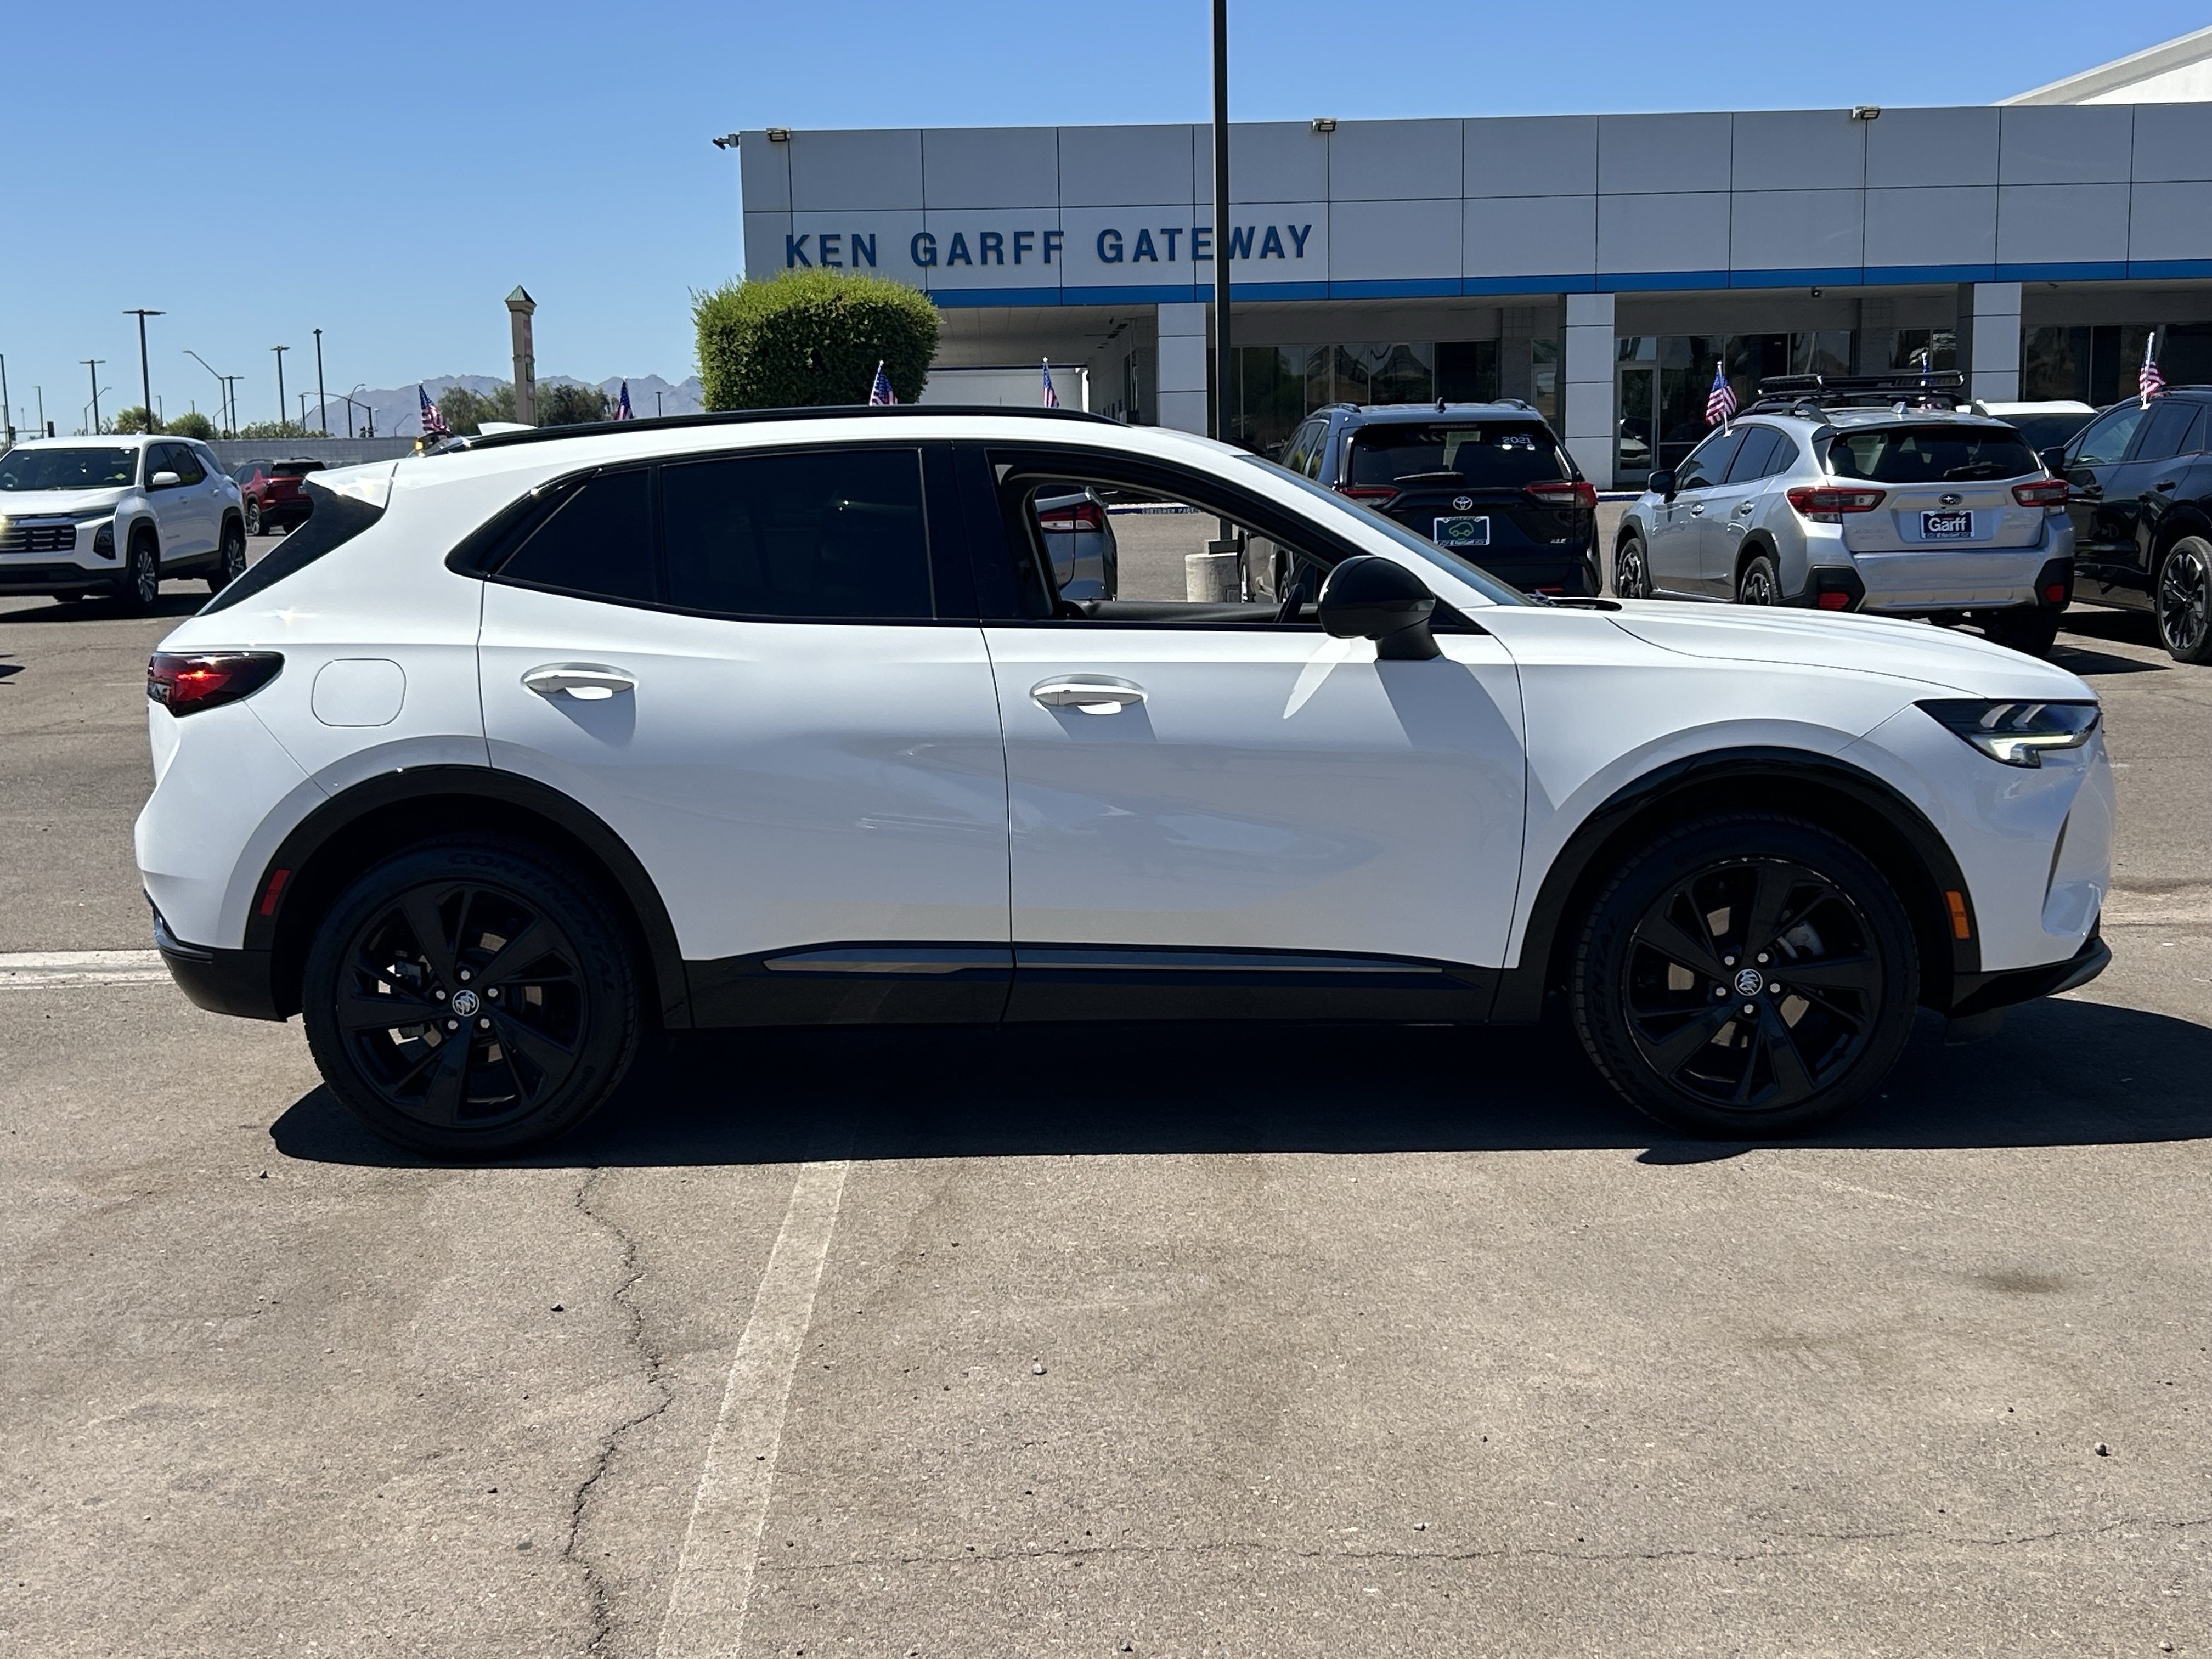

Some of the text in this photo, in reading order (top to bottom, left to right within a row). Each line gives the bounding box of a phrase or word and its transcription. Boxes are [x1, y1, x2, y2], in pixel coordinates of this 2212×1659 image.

[786, 225, 1312, 268] KEN GARFF GATEWAY
[1928, 517, 1966, 532] Garff
